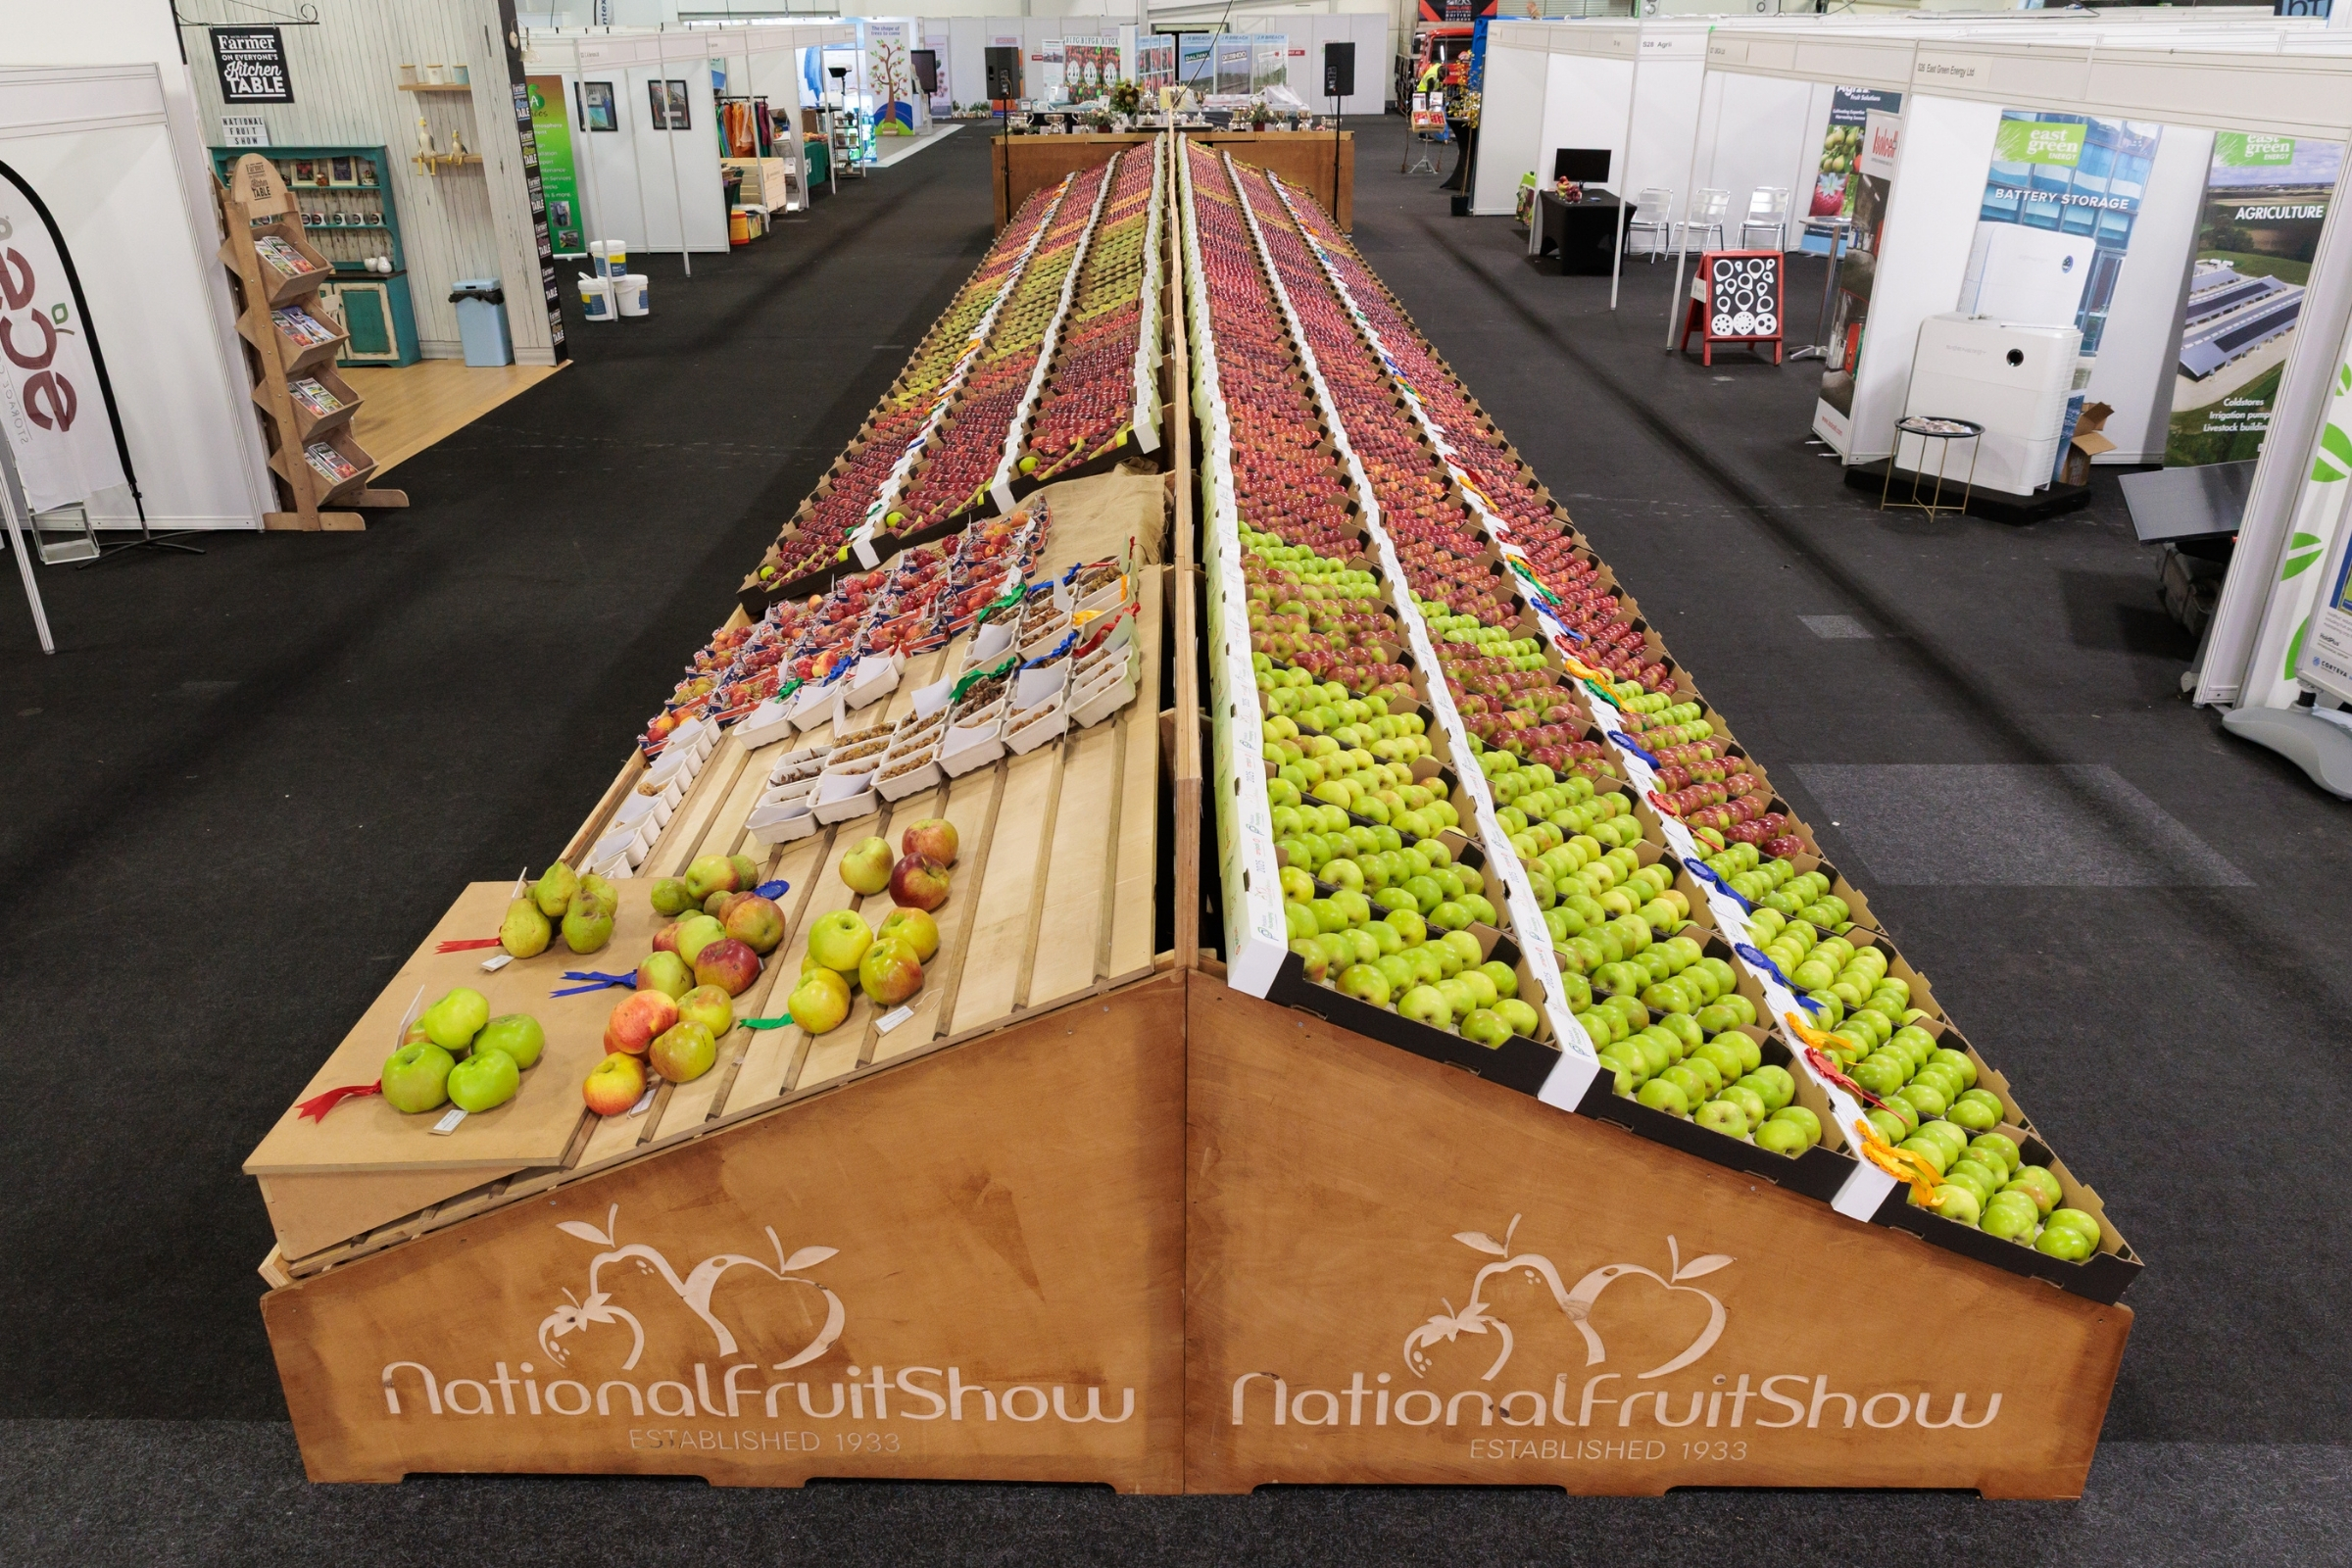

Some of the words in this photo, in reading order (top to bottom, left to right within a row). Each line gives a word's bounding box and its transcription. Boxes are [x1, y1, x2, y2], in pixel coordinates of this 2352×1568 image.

[217, 35, 274, 50] Farmer
[224, 61, 281, 80] Kitchen
[1927, 64, 1936, 74] East
[1937, 65, 1949, 74] Green
[1950, 66, 1966, 77] Energy
[226, 76, 285, 93] TABLE
[516, 108, 530, 118] TABLE
[2031, 129, 2068, 141] east
[2247, 134, 2279, 143] east
[2027, 139, 2078, 155] green
[2244, 143, 2290, 157] green
[524, 154, 537, 166] TABLE
[252, 186, 270, 198] TABLE
[1995, 188, 2057, 203] BATTERY
[2061, 194, 2130, 210] STORAGE
[531, 200, 544, 212] TABLE
[2235, 206, 2325, 220] AGRICULTURE
[539, 244, 551, 256] TABLE
[546, 287, 558, 300] TABLE
[553, 330, 564, 343] TABLE
[2224, 398, 2264, 407] Coldstores
[2209, 411, 2246, 421] Irrigation
[2247, 412, 2271, 420] pump
[2203, 422, 2238, 432] Livestock
[2239, 421, 2268, 431] buildin
[2321, 661, 2348, 677] CORTEVA
[1246, 770, 1254, 783] 2025
[1255, 859, 1266, 873] 2025
[1508, 871, 1519, 883] 2025
[629, 1428, 821, 1452] ESTABLISHED
[835, 1431, 901, 1454] 1933
[1470, 1439, 1666, 1461] ESTABLISHED
[1680, 1440, 1748, 1462] 1933
